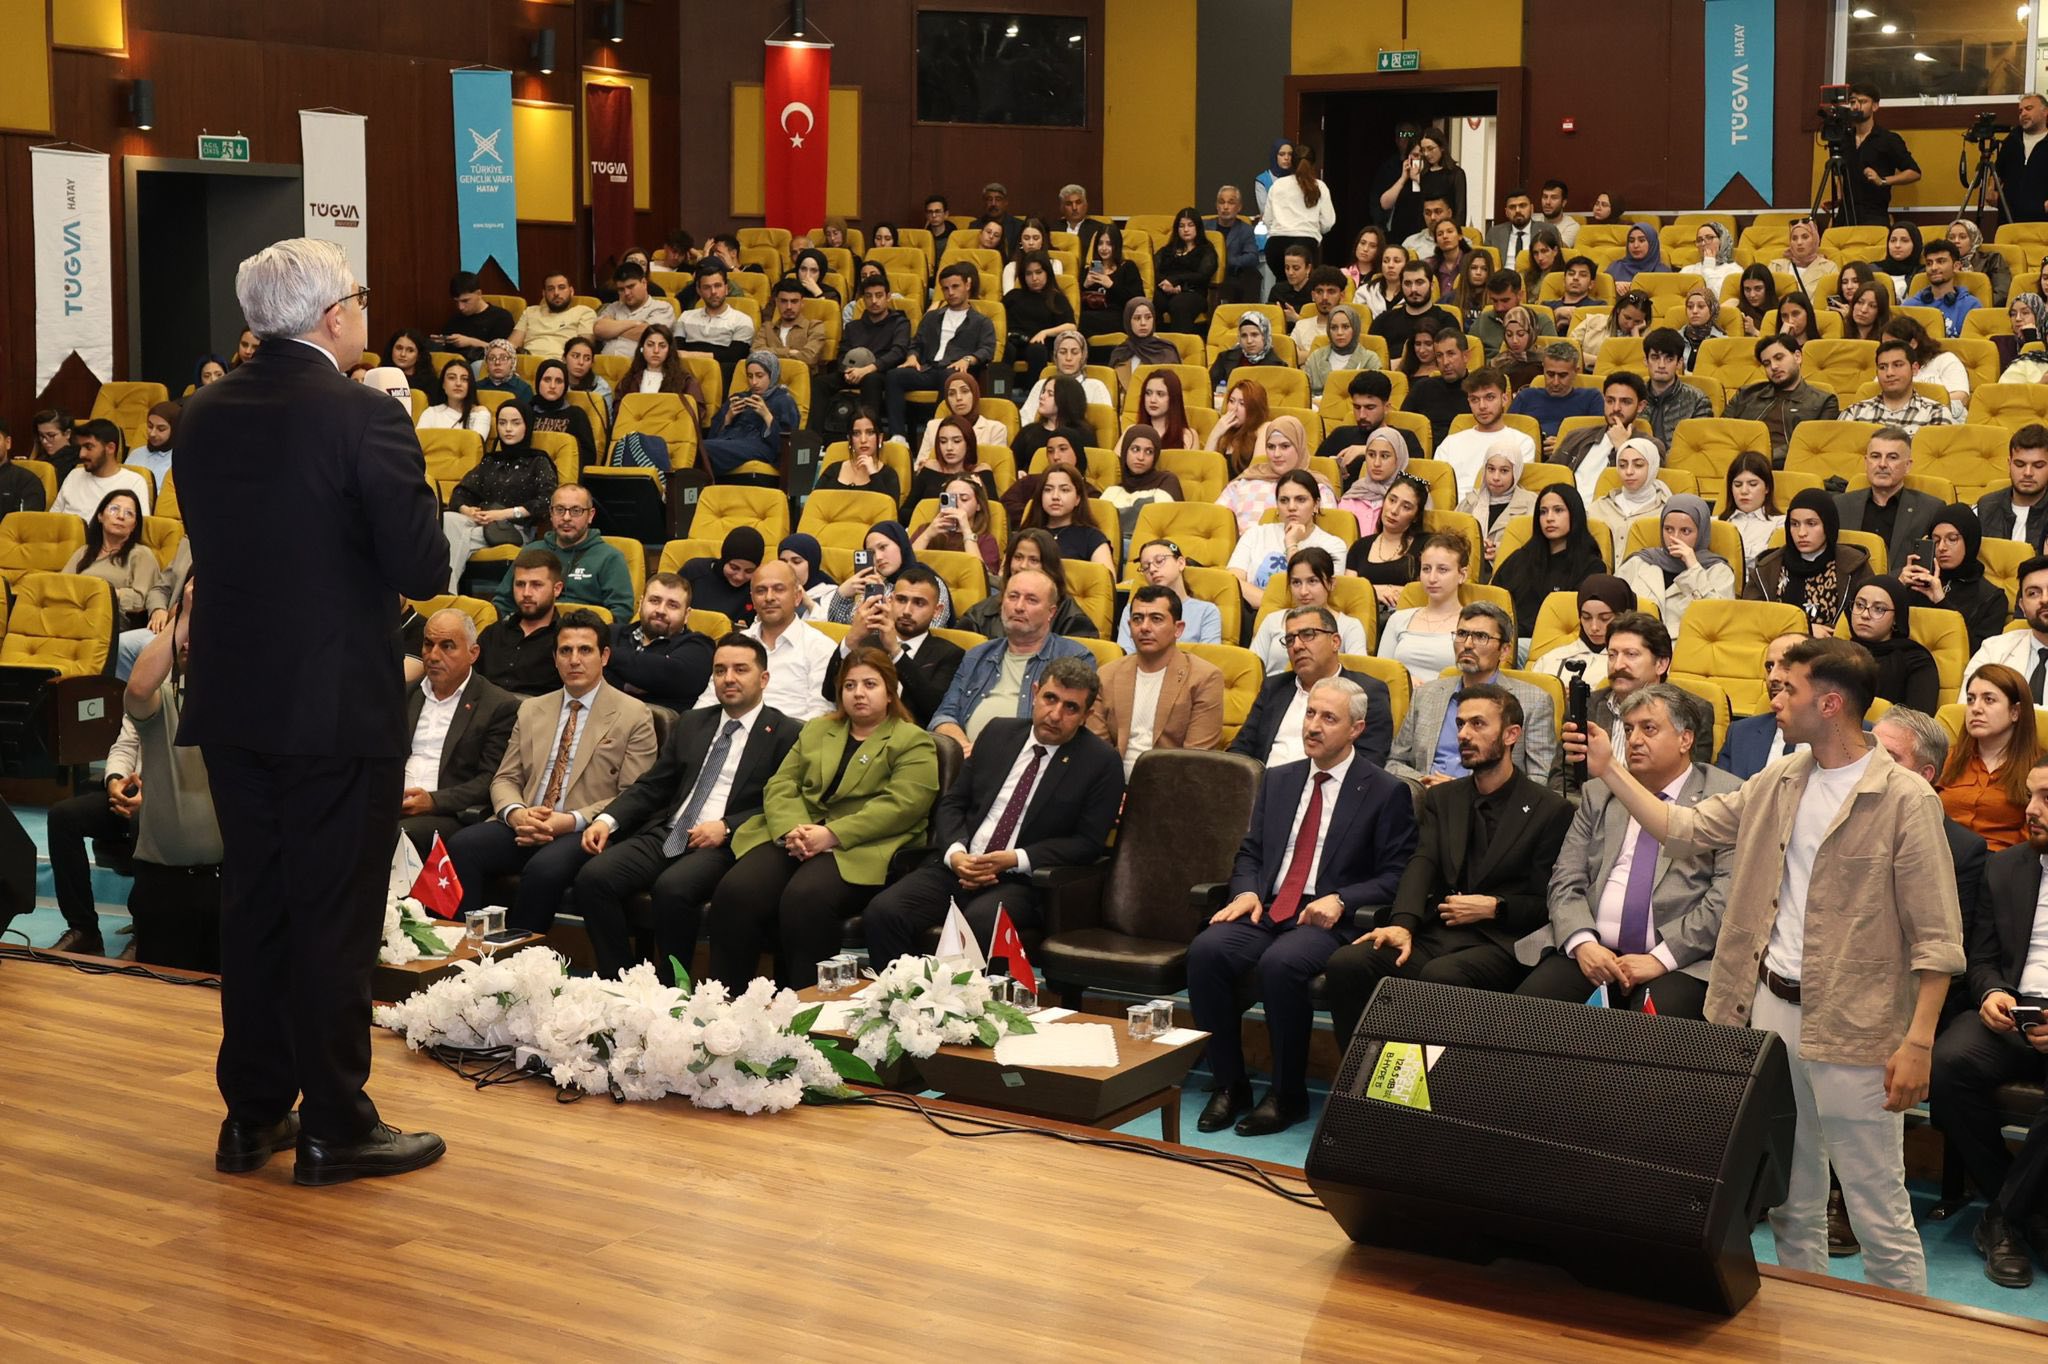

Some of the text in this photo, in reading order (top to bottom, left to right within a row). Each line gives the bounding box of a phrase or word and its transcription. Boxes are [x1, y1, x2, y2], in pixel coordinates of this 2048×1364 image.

[1731, 24, 1749, 145] TÜGVA HATAY
[470, 164, 503, 174] TÜRKİYE
[591, 161, 628, 175] TÜGVA
[310, 203, 359, 219] TÜGVA
[63, 178, 83, 316] TÜGVA HATAY
[87, 701, 96, 716] C
[1377, 1052, 1394, 1080] B-HYPE
[1392, 1058, 1405, 1079] 126.5
[1386, 1078, 1396, 1089] dB
